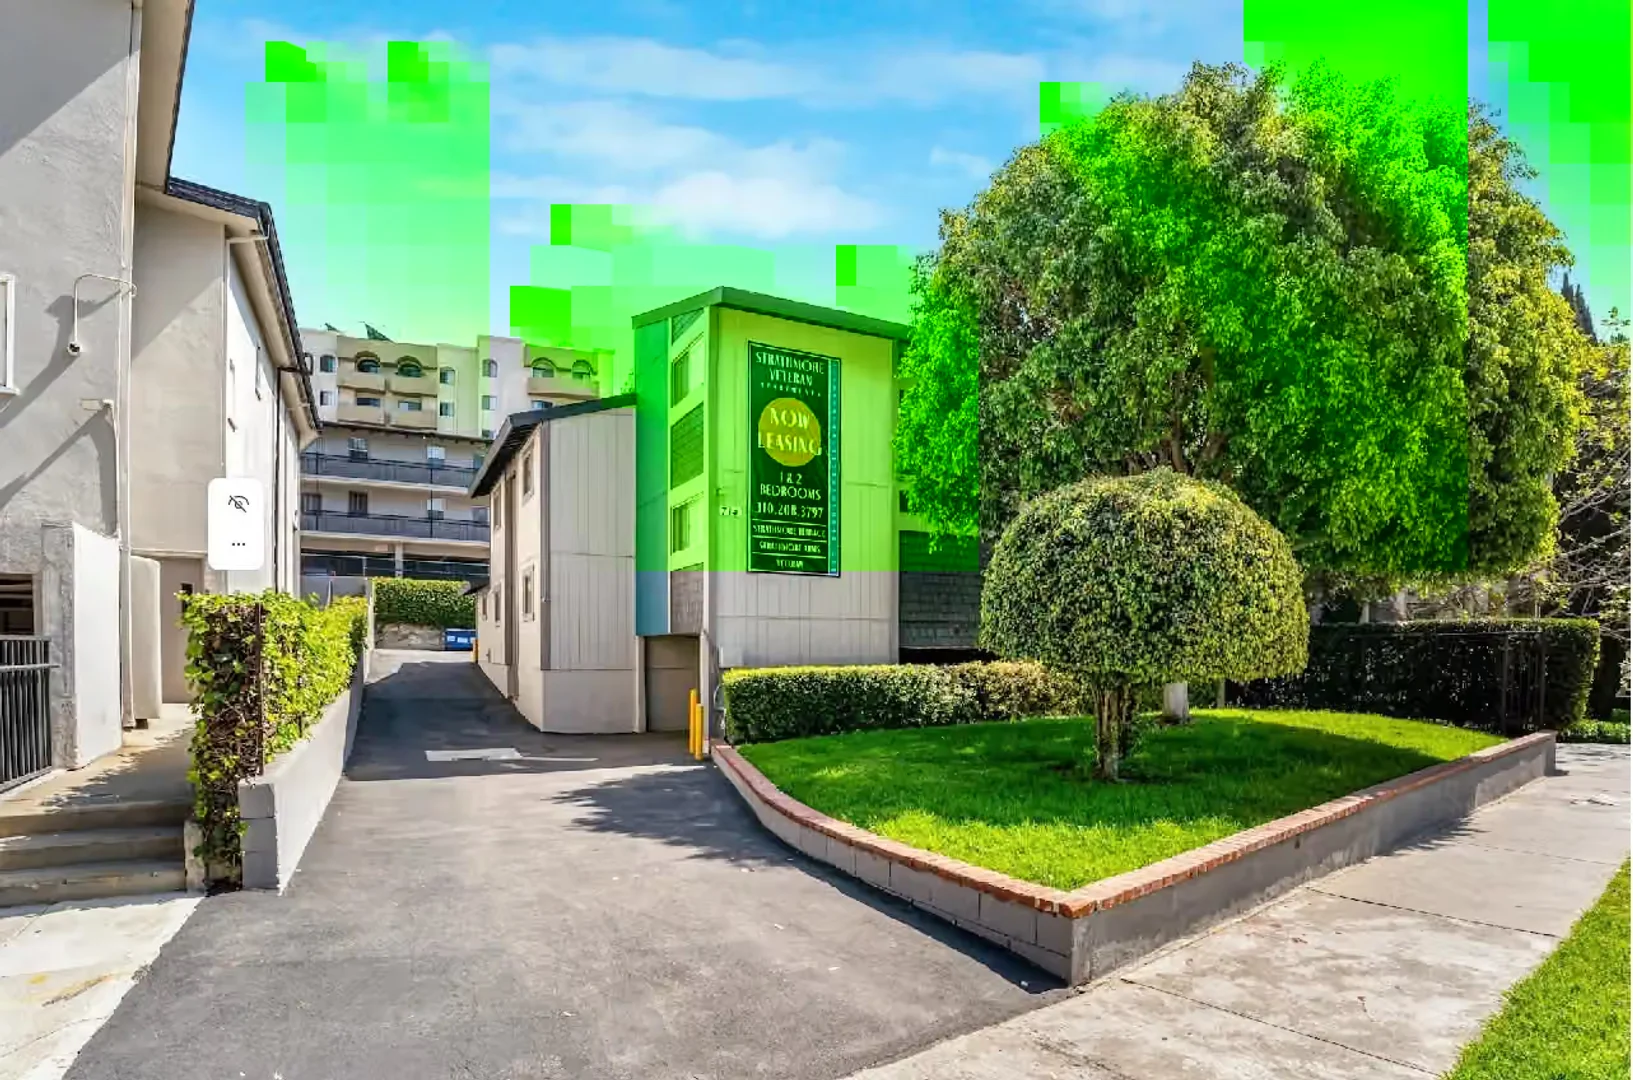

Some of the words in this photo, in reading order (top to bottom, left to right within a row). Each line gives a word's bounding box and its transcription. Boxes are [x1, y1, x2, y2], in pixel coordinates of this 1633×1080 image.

[755, 351, 825, 375] STRATHMORE
[769, 367, 813, 386] VETERAN
[770, 407, 810, 430] NOW
[758, 431, 822, 456] LEASING
[796, 473, 802, 485] 2
[760, 483, 822, 501] BEDROOMS
